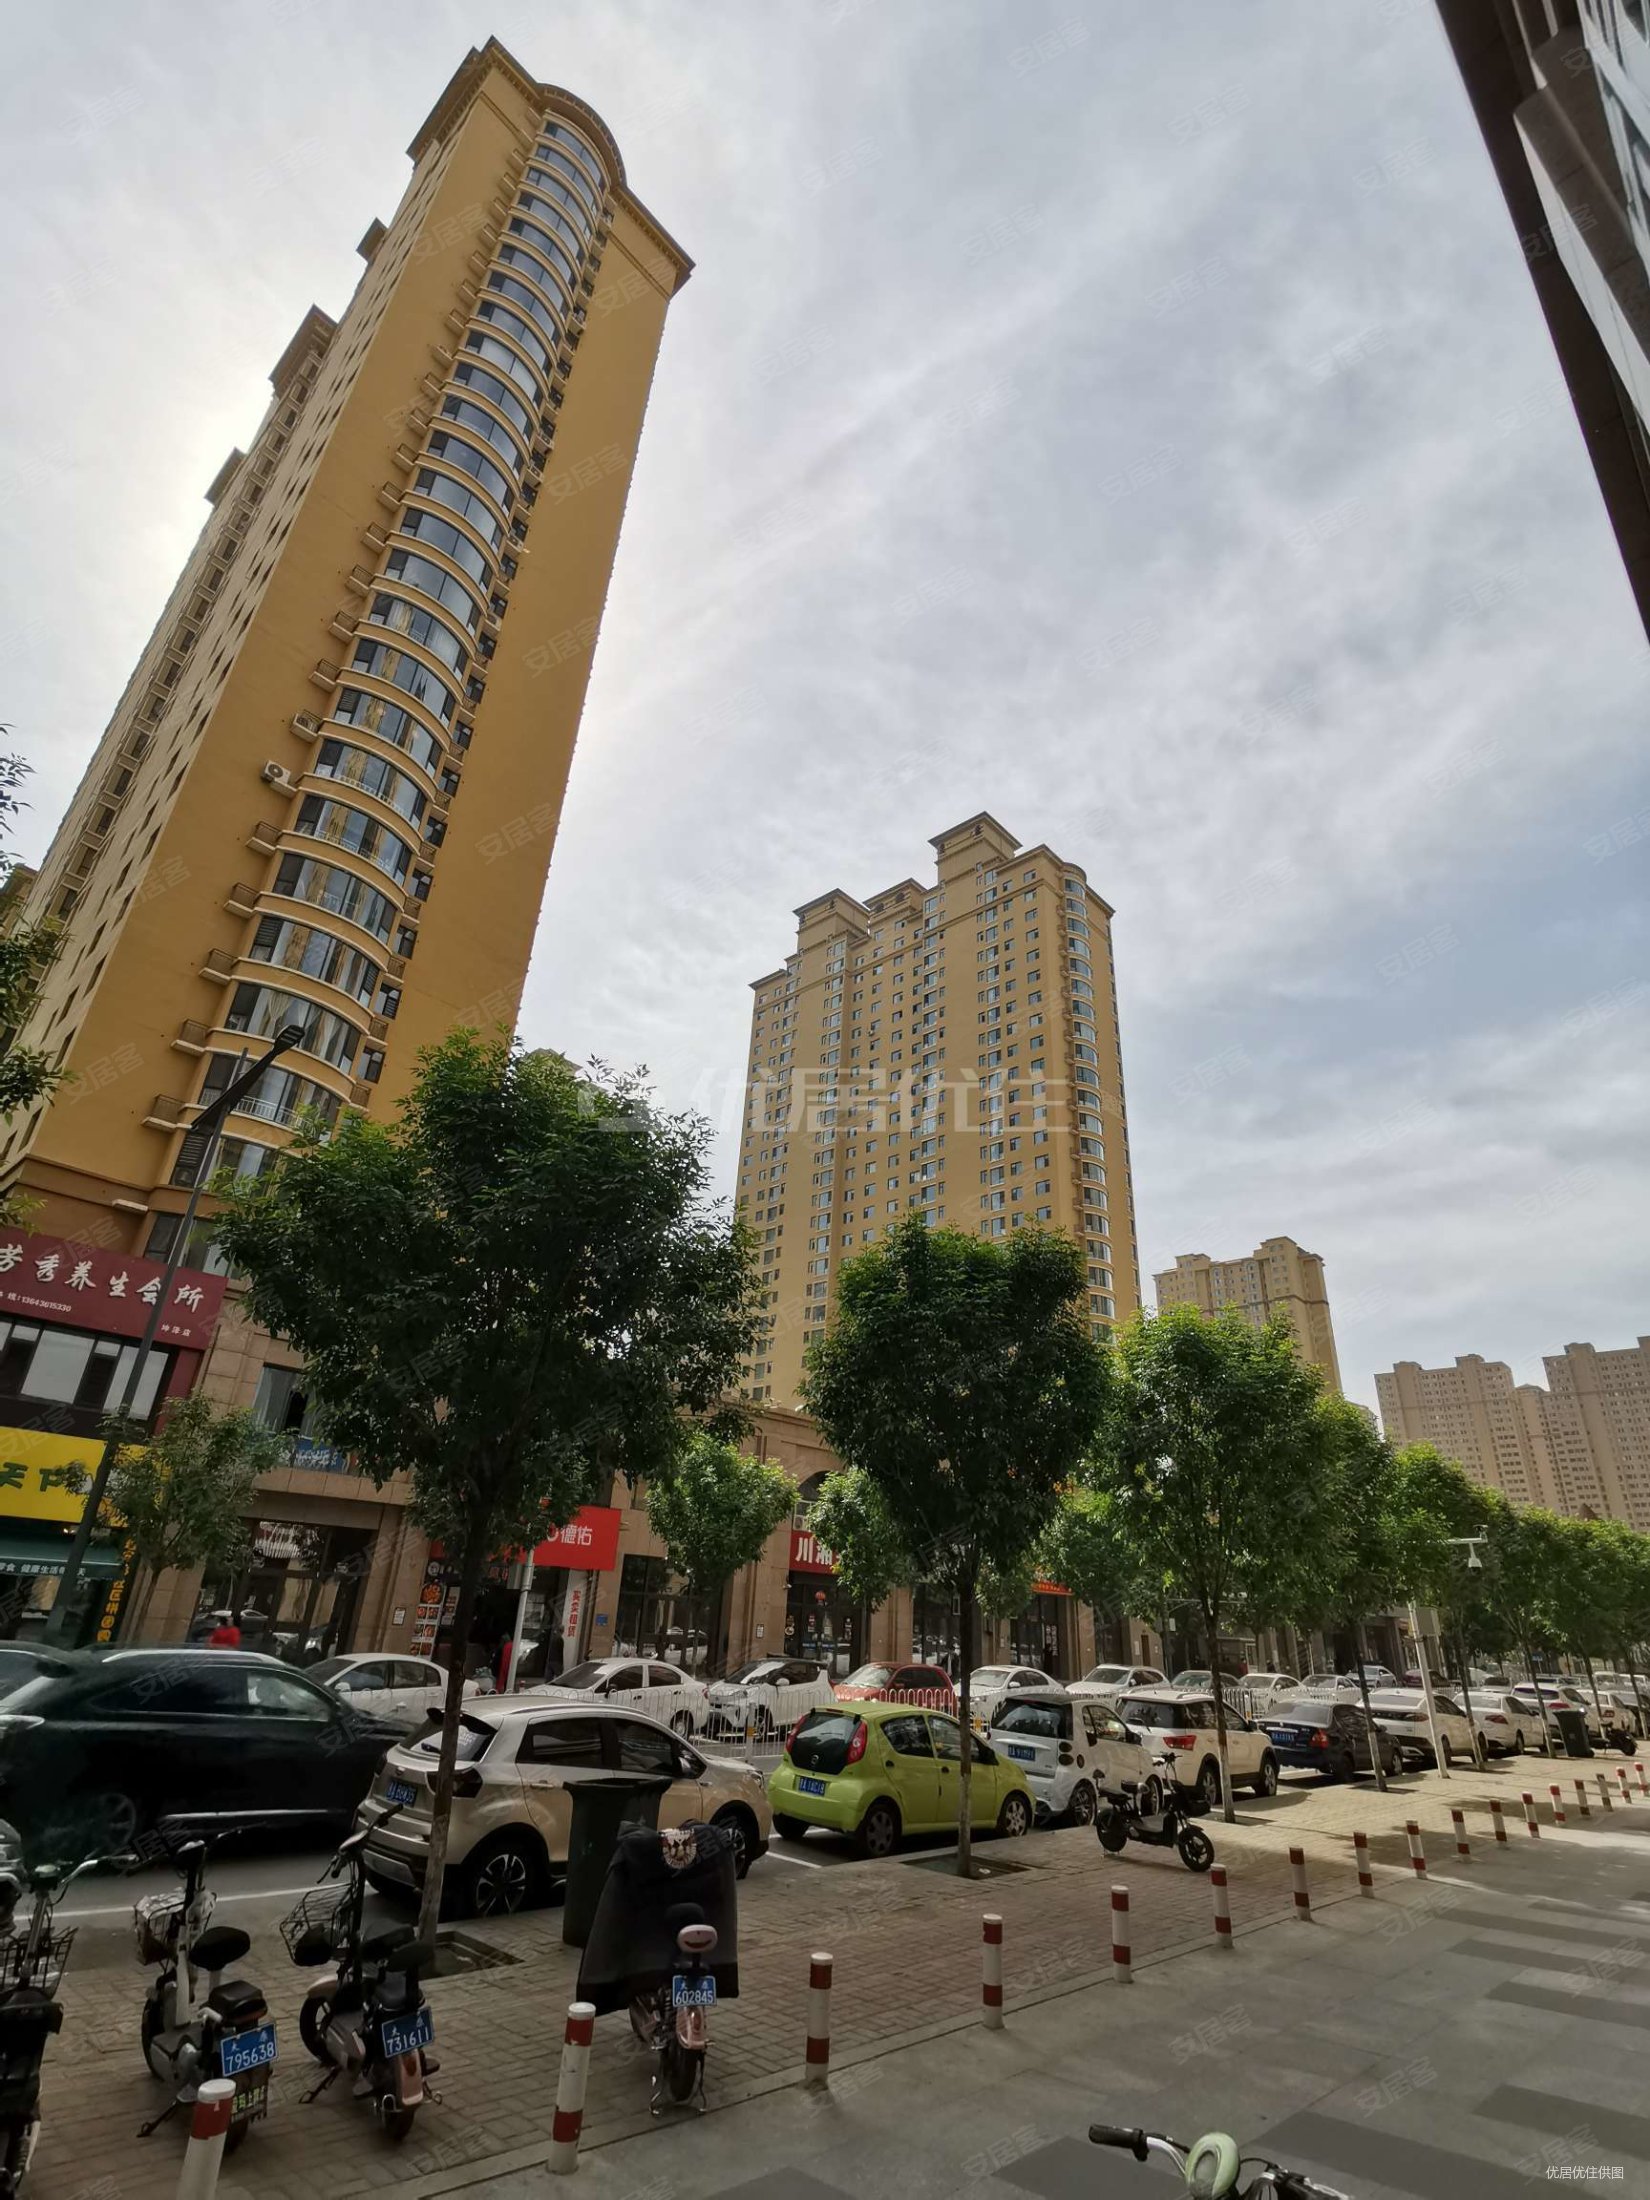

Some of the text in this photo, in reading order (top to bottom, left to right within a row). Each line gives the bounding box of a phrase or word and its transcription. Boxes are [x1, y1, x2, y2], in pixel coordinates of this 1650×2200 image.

[560, 1524, 593, 1546] 德佑
[676, 1989, 714, 2005] 602845
[387, 2026, 429, 2055] 731611
[225, 2041, 275, 2072] 795638
